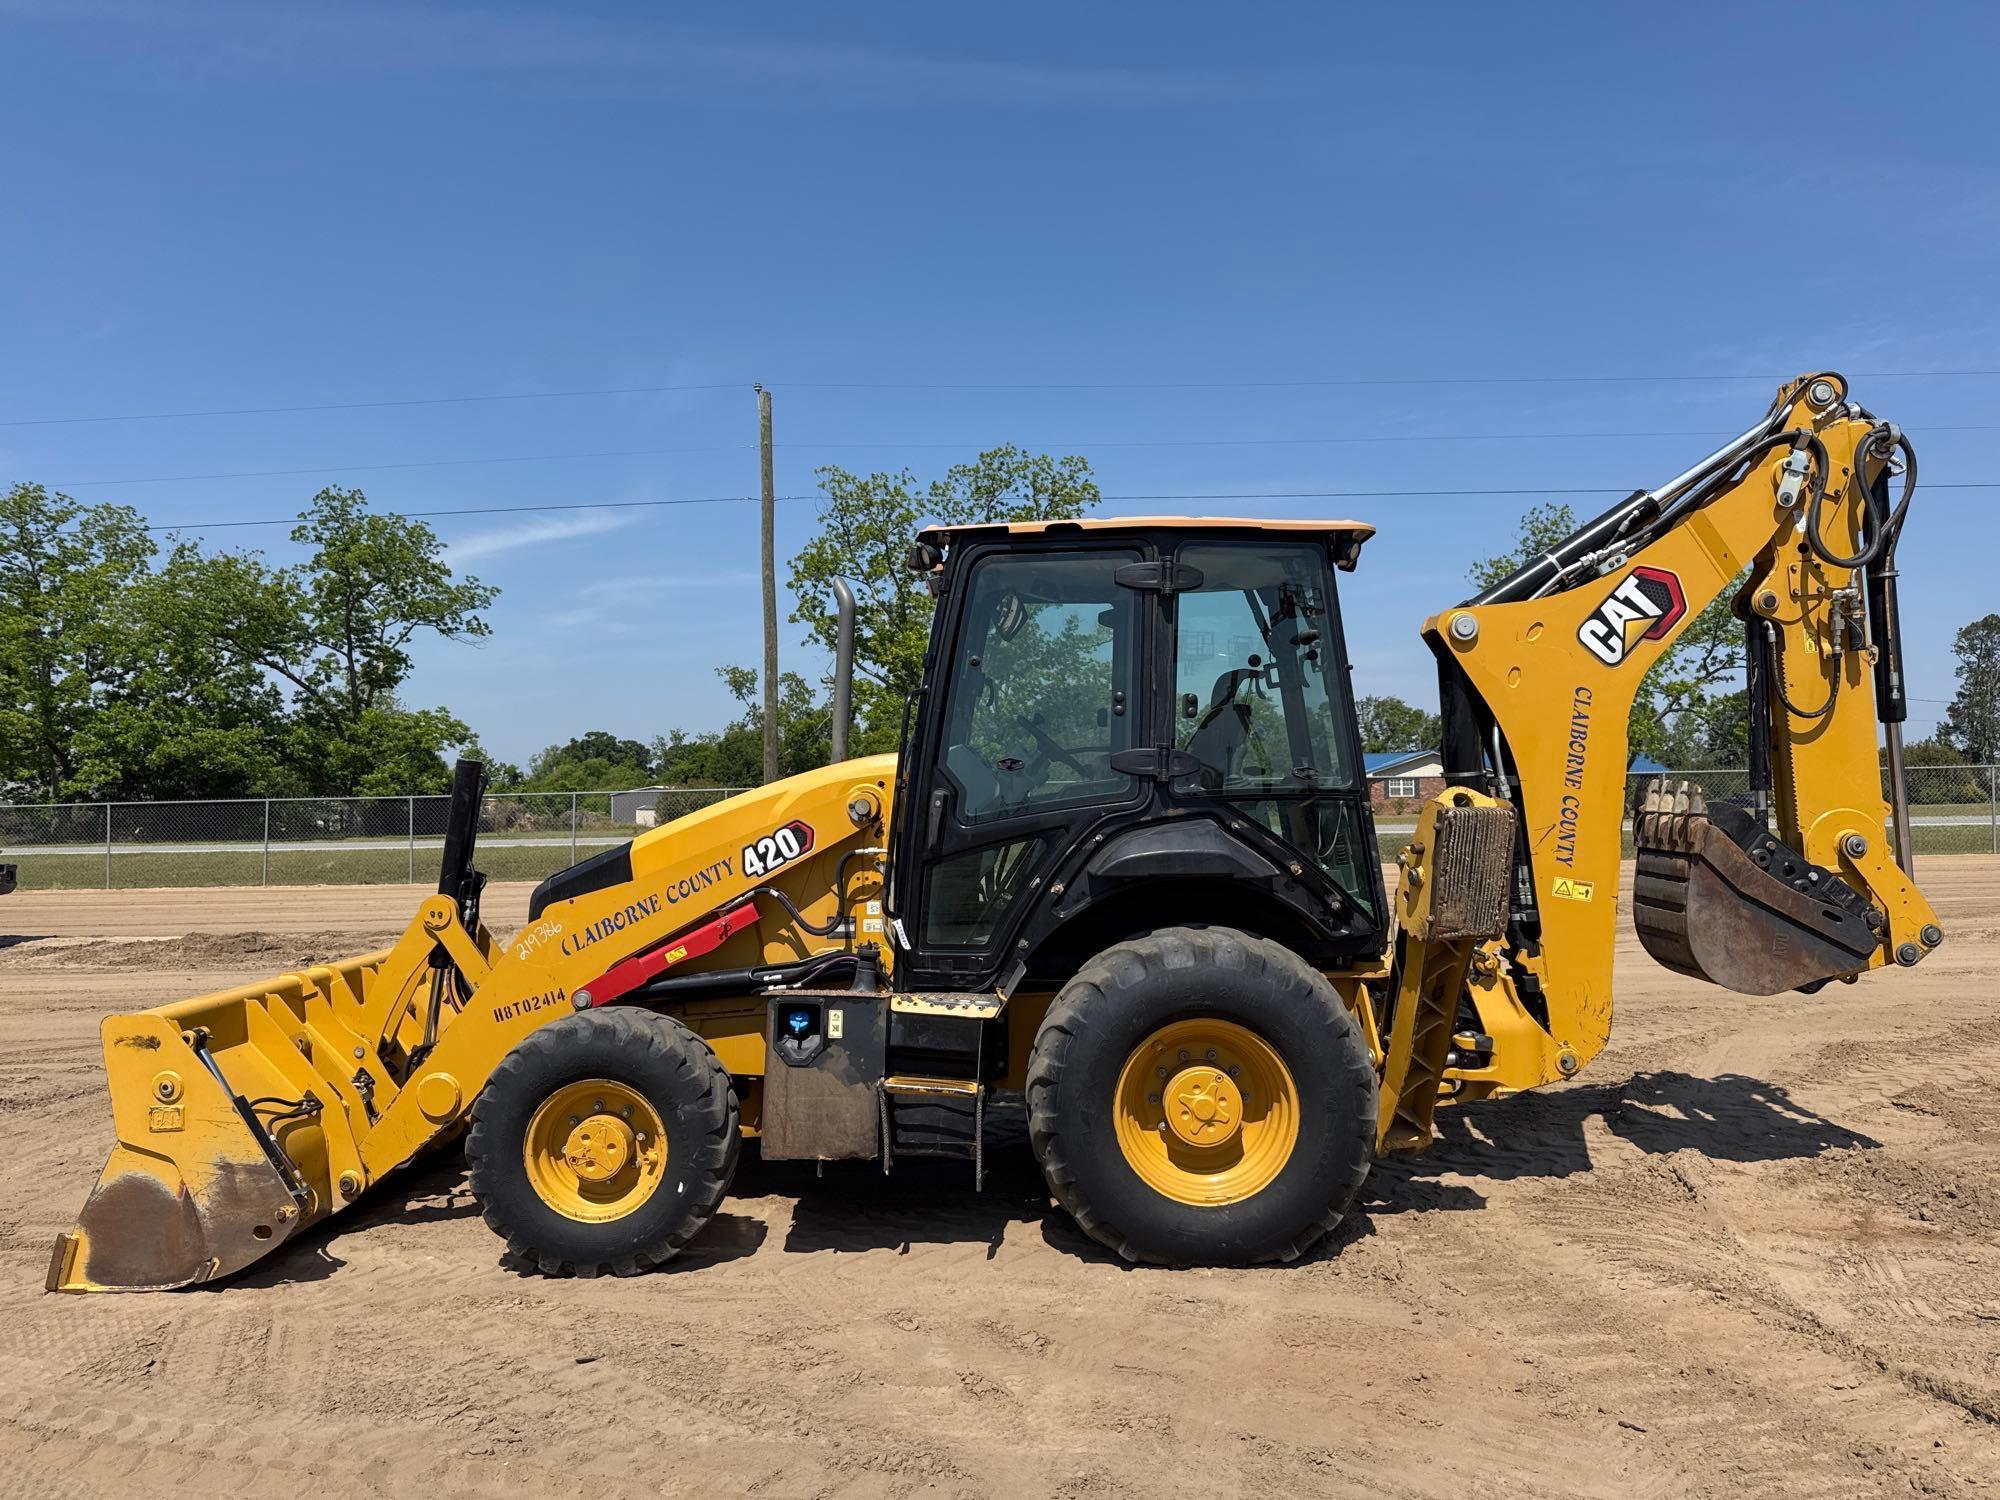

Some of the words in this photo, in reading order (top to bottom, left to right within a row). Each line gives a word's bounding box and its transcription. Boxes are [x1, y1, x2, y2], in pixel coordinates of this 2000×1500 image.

[1579, 574, 1663, 664] CAT
[1564, 686, 1592, 789] CLAIBORNE
[744, 828, 800, 875] 420
[1555, 795, 1580, 868] COUNTY
[666, 857, 734, 904] COUNTY
[516, 920, 562, 960] 219386
